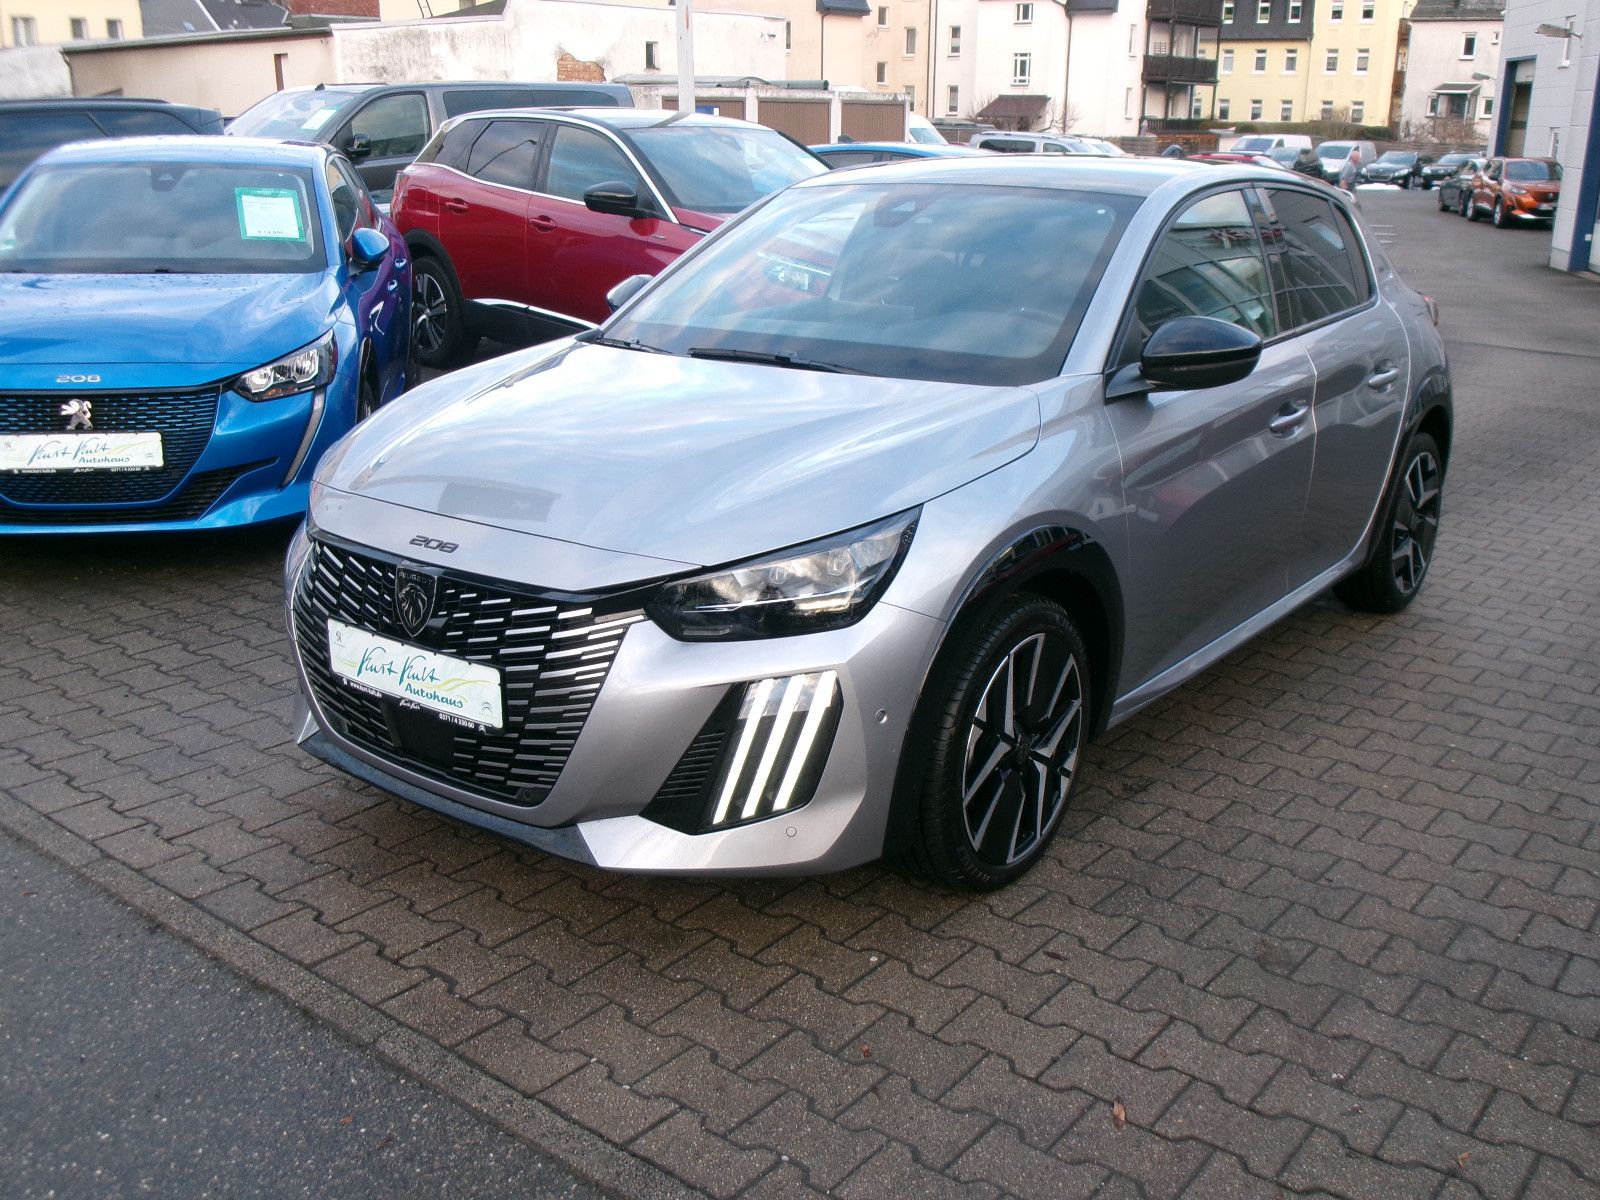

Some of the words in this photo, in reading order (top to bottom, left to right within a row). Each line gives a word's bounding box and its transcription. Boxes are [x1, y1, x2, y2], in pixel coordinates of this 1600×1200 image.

[56, 375, 101, 383] 208
[78, 456, 130, 464] Autohaus
[409, 535, 459, 553] 208
[398, 571, 434, 586] PEUGEOT
[357, 647, 398, 677] Kurt
[399, 655, 440, 686] Kult
[404, 682, 464, 709] Autohaus
